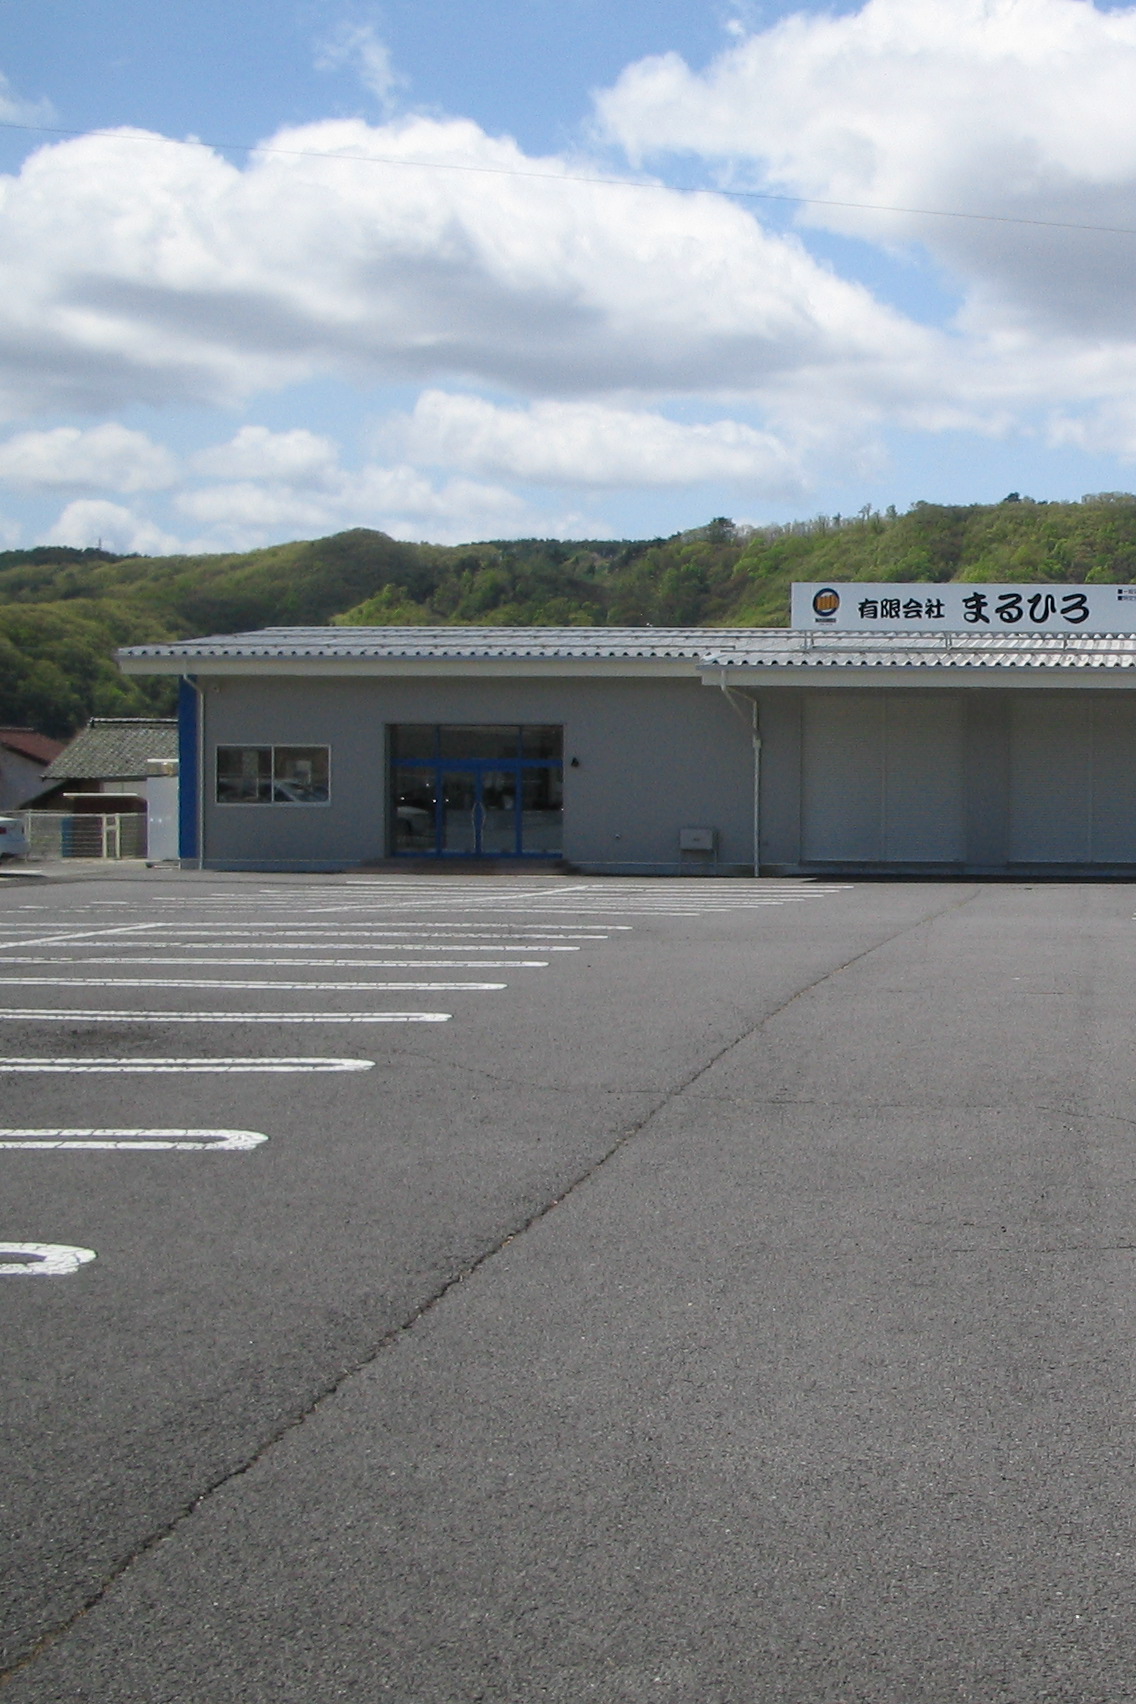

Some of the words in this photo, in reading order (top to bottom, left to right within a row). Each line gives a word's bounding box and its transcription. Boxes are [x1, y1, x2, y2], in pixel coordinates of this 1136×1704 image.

[858, 598, 945, 619] 有限会社
[962, 592, 1090, 624] まるひろ
